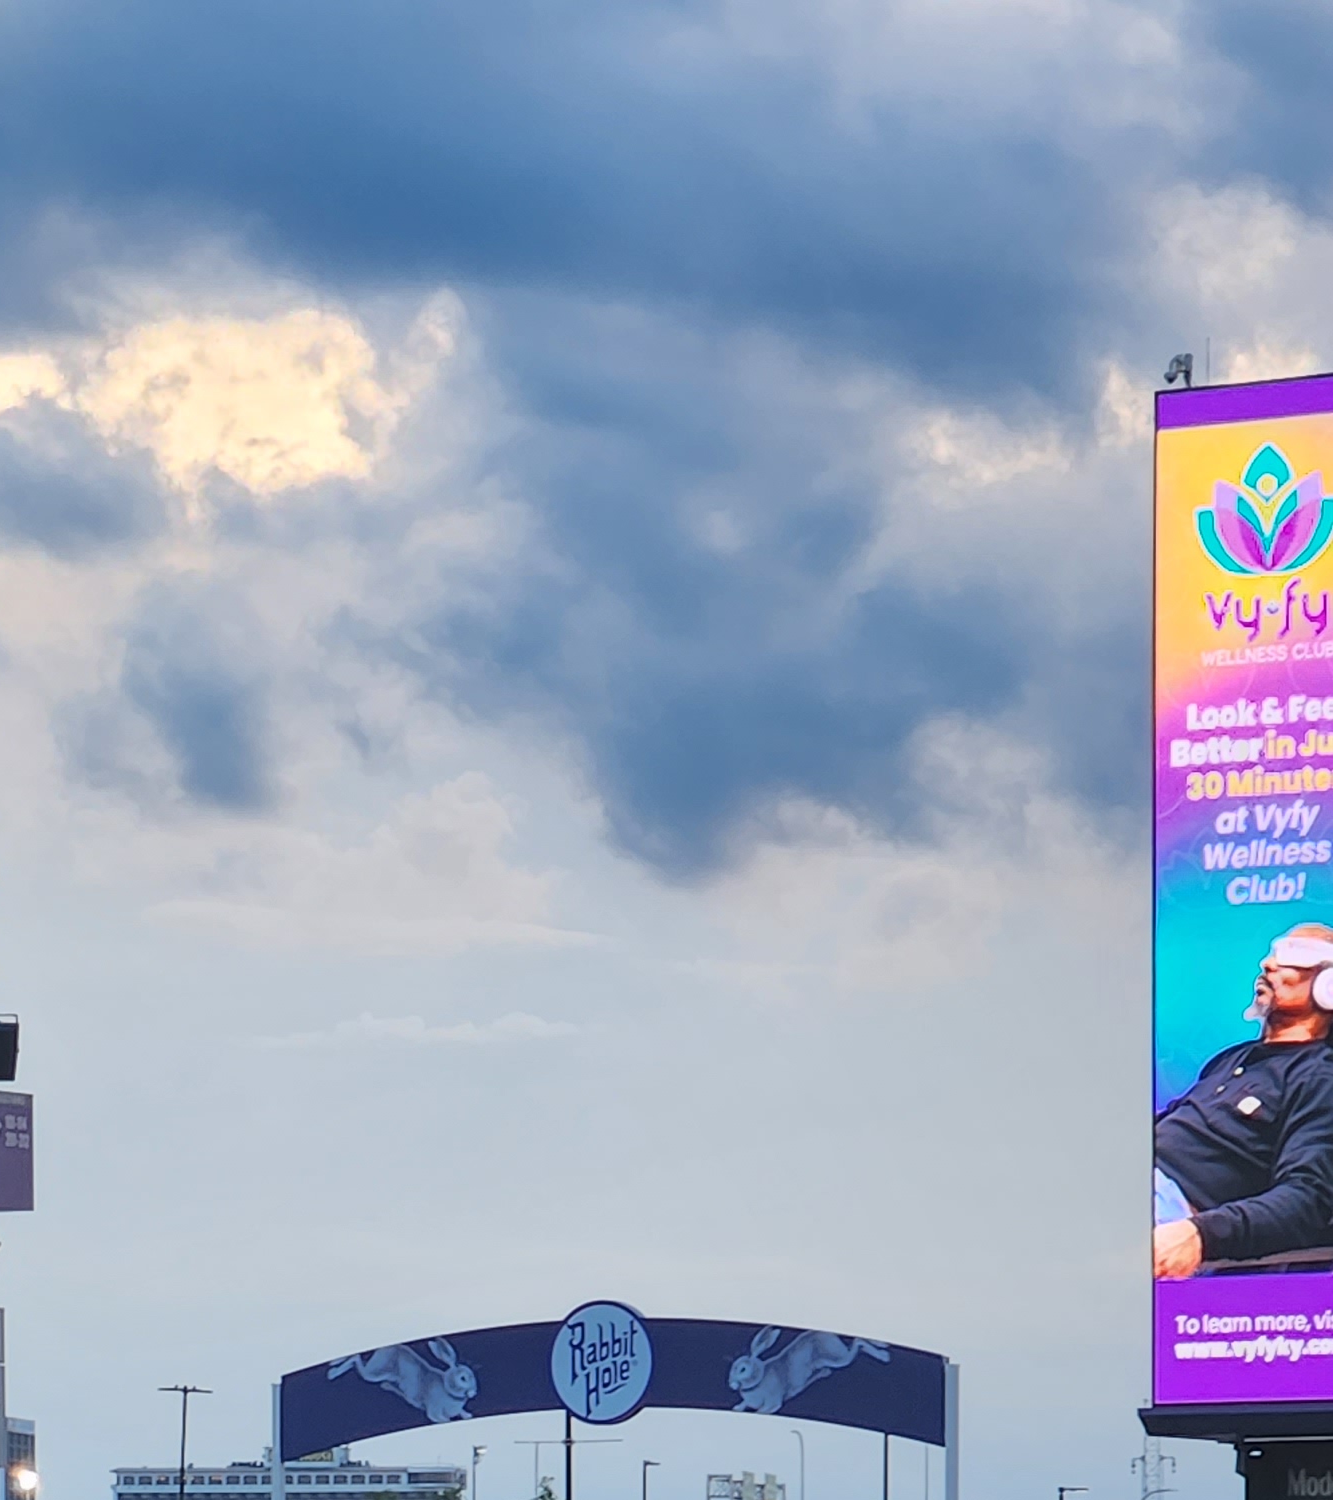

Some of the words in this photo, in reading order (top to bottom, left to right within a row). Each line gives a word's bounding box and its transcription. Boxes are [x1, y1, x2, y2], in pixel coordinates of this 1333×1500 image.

[1200, 644, 1287, 667] WELLNESS
[1186, 698, 1258, 731] Look
[1260, 697, 1284, 725] &
[1170, 734, 1263, 767] Better
[1264, 729, 1297, 759] in
[1186, 768, 1224, 801] 30
[1226, 764, 1333, 797] Minute
[1215, 805, 1250, 835] at
[1253, 800, 1321, 838] Vyfy
[1203, 838, 1333, 871] Wellness
[1226, 872, 1307, 905] Club!
[1174, 1314, 1201, 1335] To
[1254, 1313, 1312, 1333] more,
[1313, 1309, 1333, 1330] vi
[567, 1319, 638, 1387] Rabbit
[584, 1359, 631, 1419] Hole
